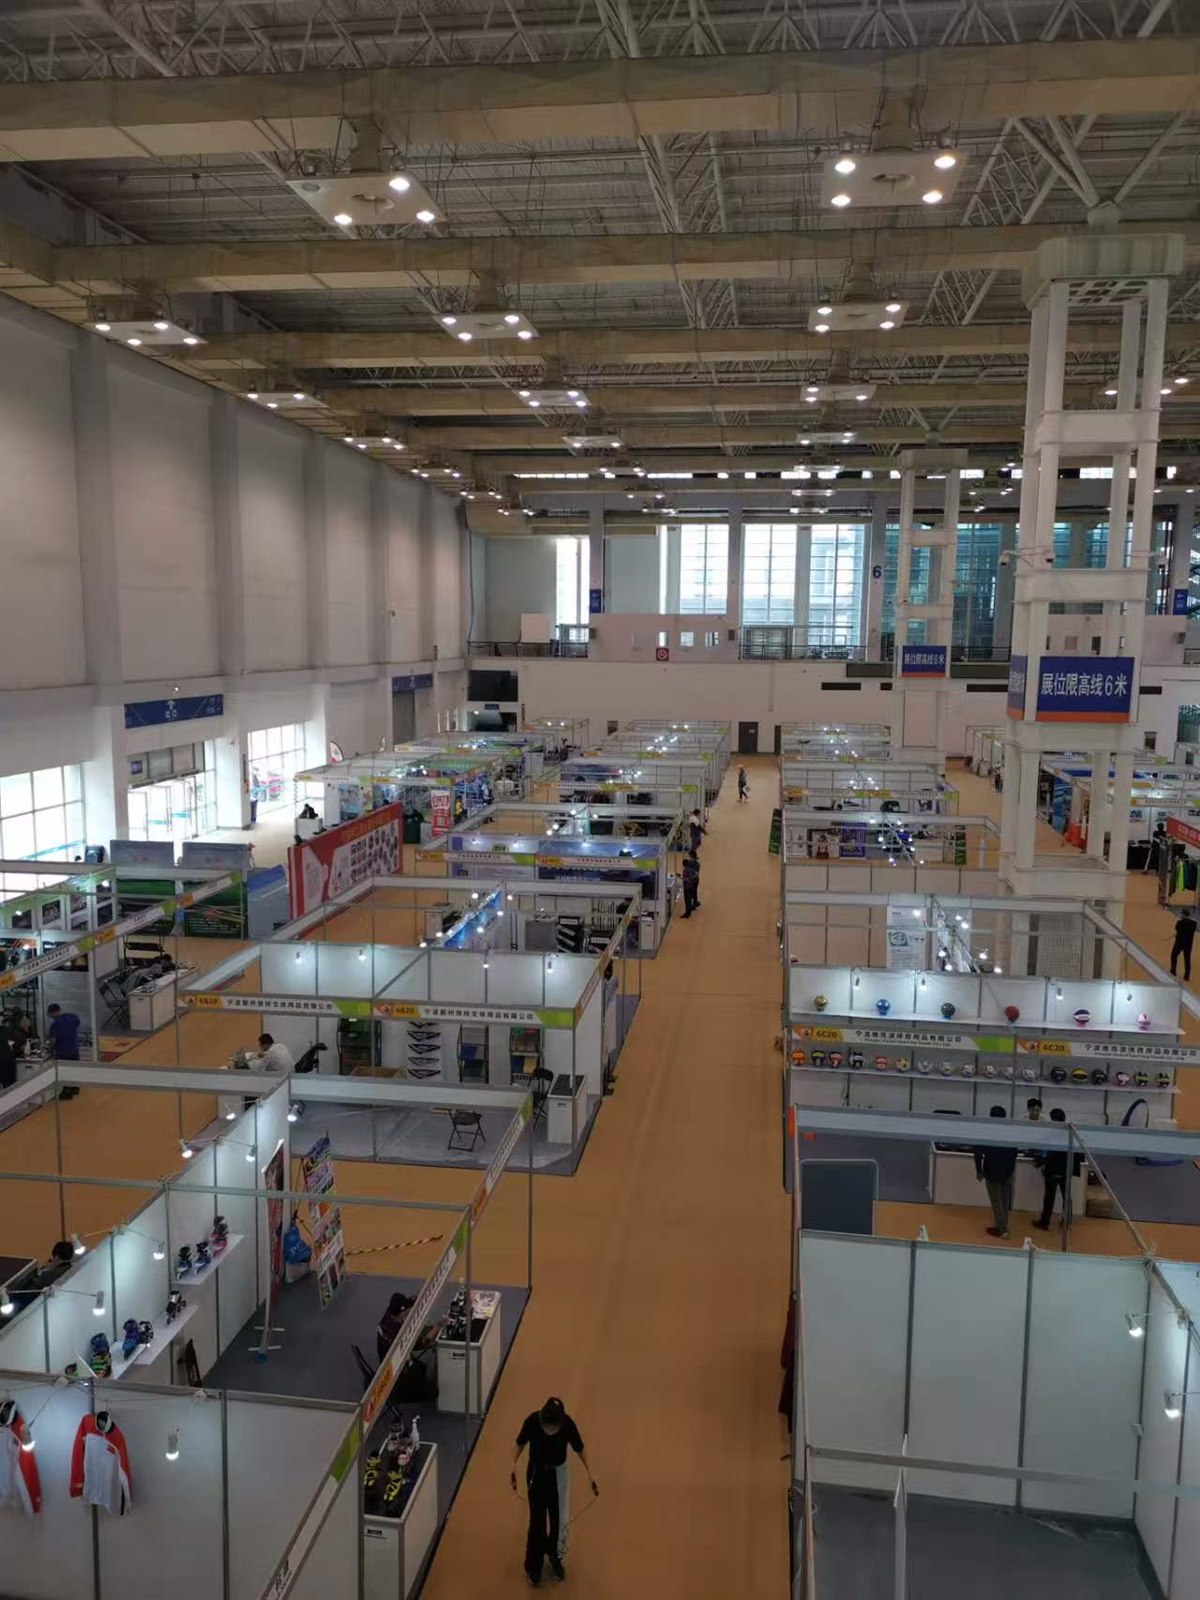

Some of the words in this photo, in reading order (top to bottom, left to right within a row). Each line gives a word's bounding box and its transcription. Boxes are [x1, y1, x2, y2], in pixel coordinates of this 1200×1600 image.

[872, 565, 882, 579] 6
[904, 653, 945, 665] 展位限高线6米
[1041, 673, 1128, 697] 展位限高线6米
[816, 1030, 838, 1039] 6C20
[1043, 1044, 1065, 1052] 6C20
